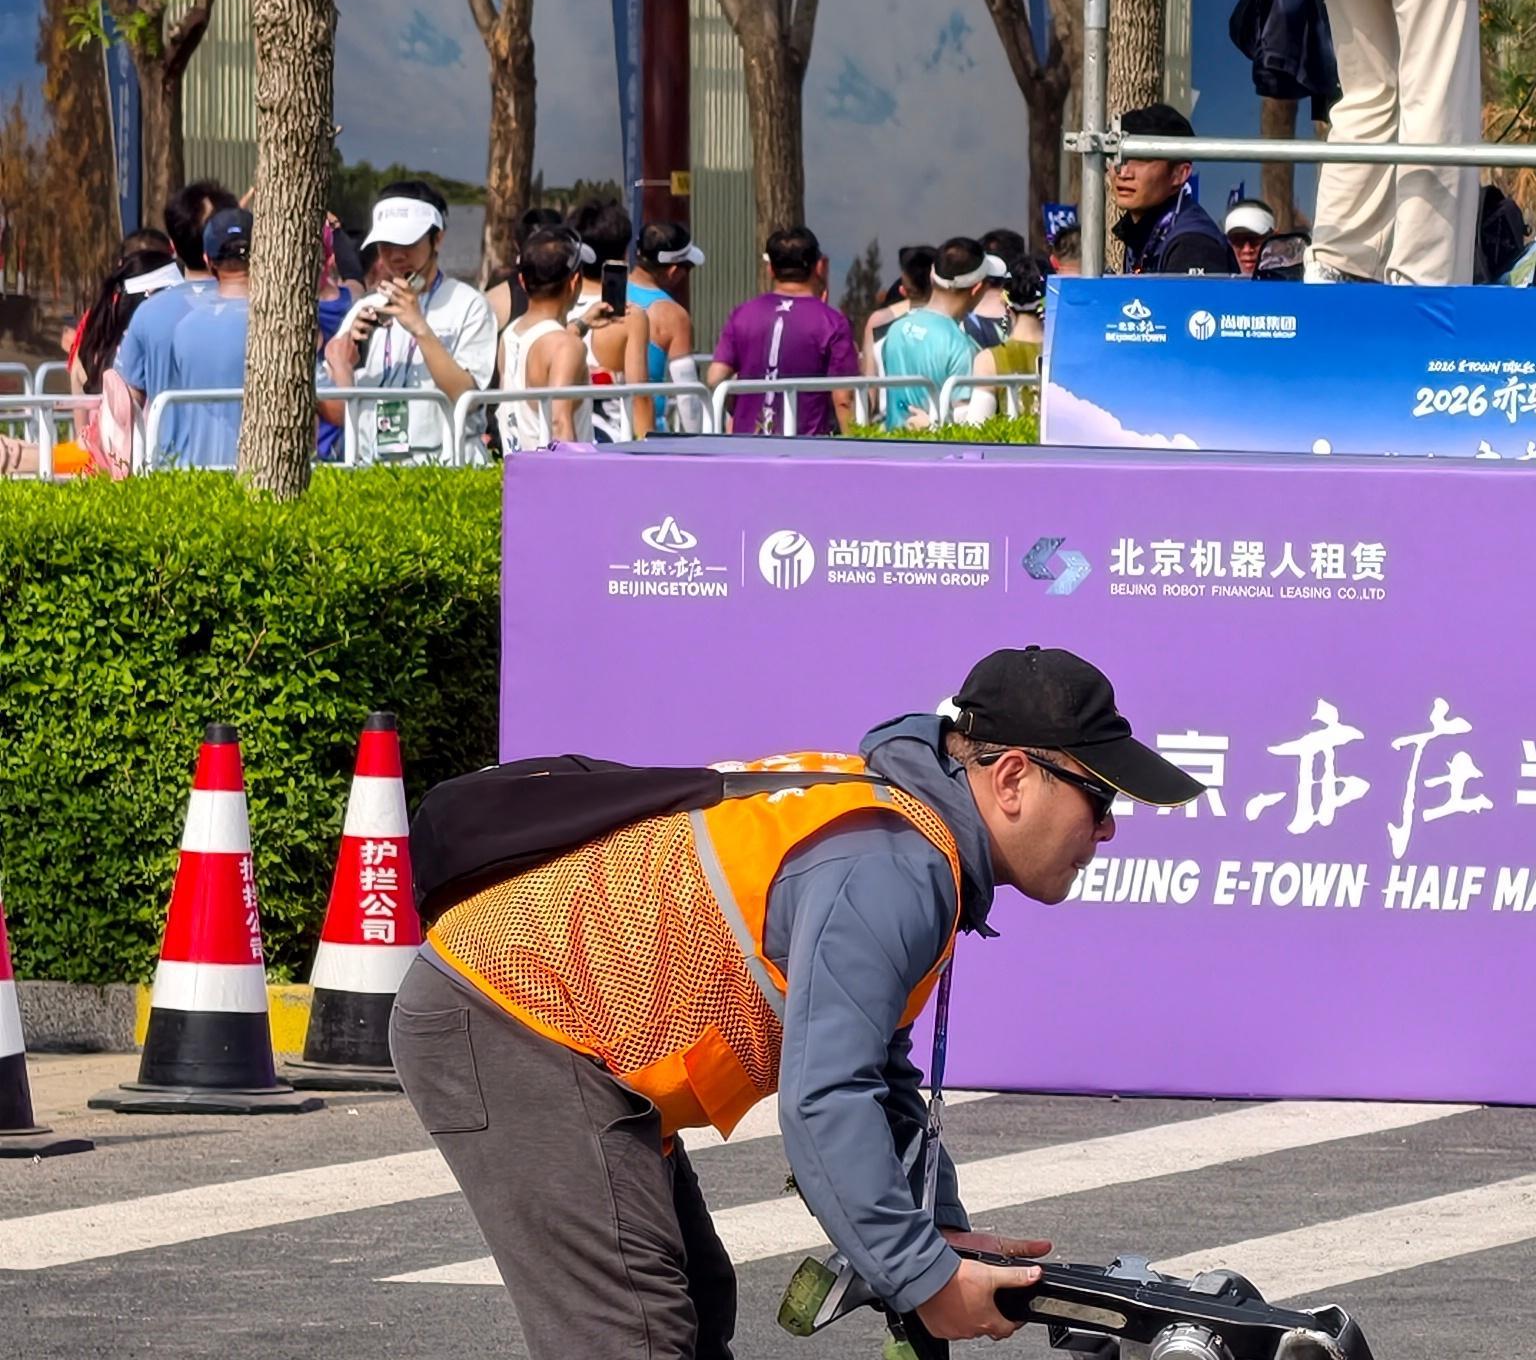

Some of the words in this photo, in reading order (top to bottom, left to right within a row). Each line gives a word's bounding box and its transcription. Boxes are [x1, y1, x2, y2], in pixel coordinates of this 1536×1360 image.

[1412, 384, 1489, 417] 2026
[827, 538, 990, 571] 尚亦城集团
[1110, 537, 1388, 582] 北京机器人租赁
[608, 580, 728, 597] BEIJINGETOWN
[827, 570, 877, 585] SHANG
[883, 571, 938, 586] E-TOWN
[940, 572, 990, 588] GROUP
[1110, 583, 1157, 597] BEIJING
[1162, 584, 1207, 598] ROBOT
[1211, 585, 1275, 599] FINANCIAL
[1279, 586, 1332, 600] LEASING
[359, 839, 399, 944] 护拦公司
[1213, 860, 1366, 908] E-TOWN
[1383, 863, 1486, 911] HALF
